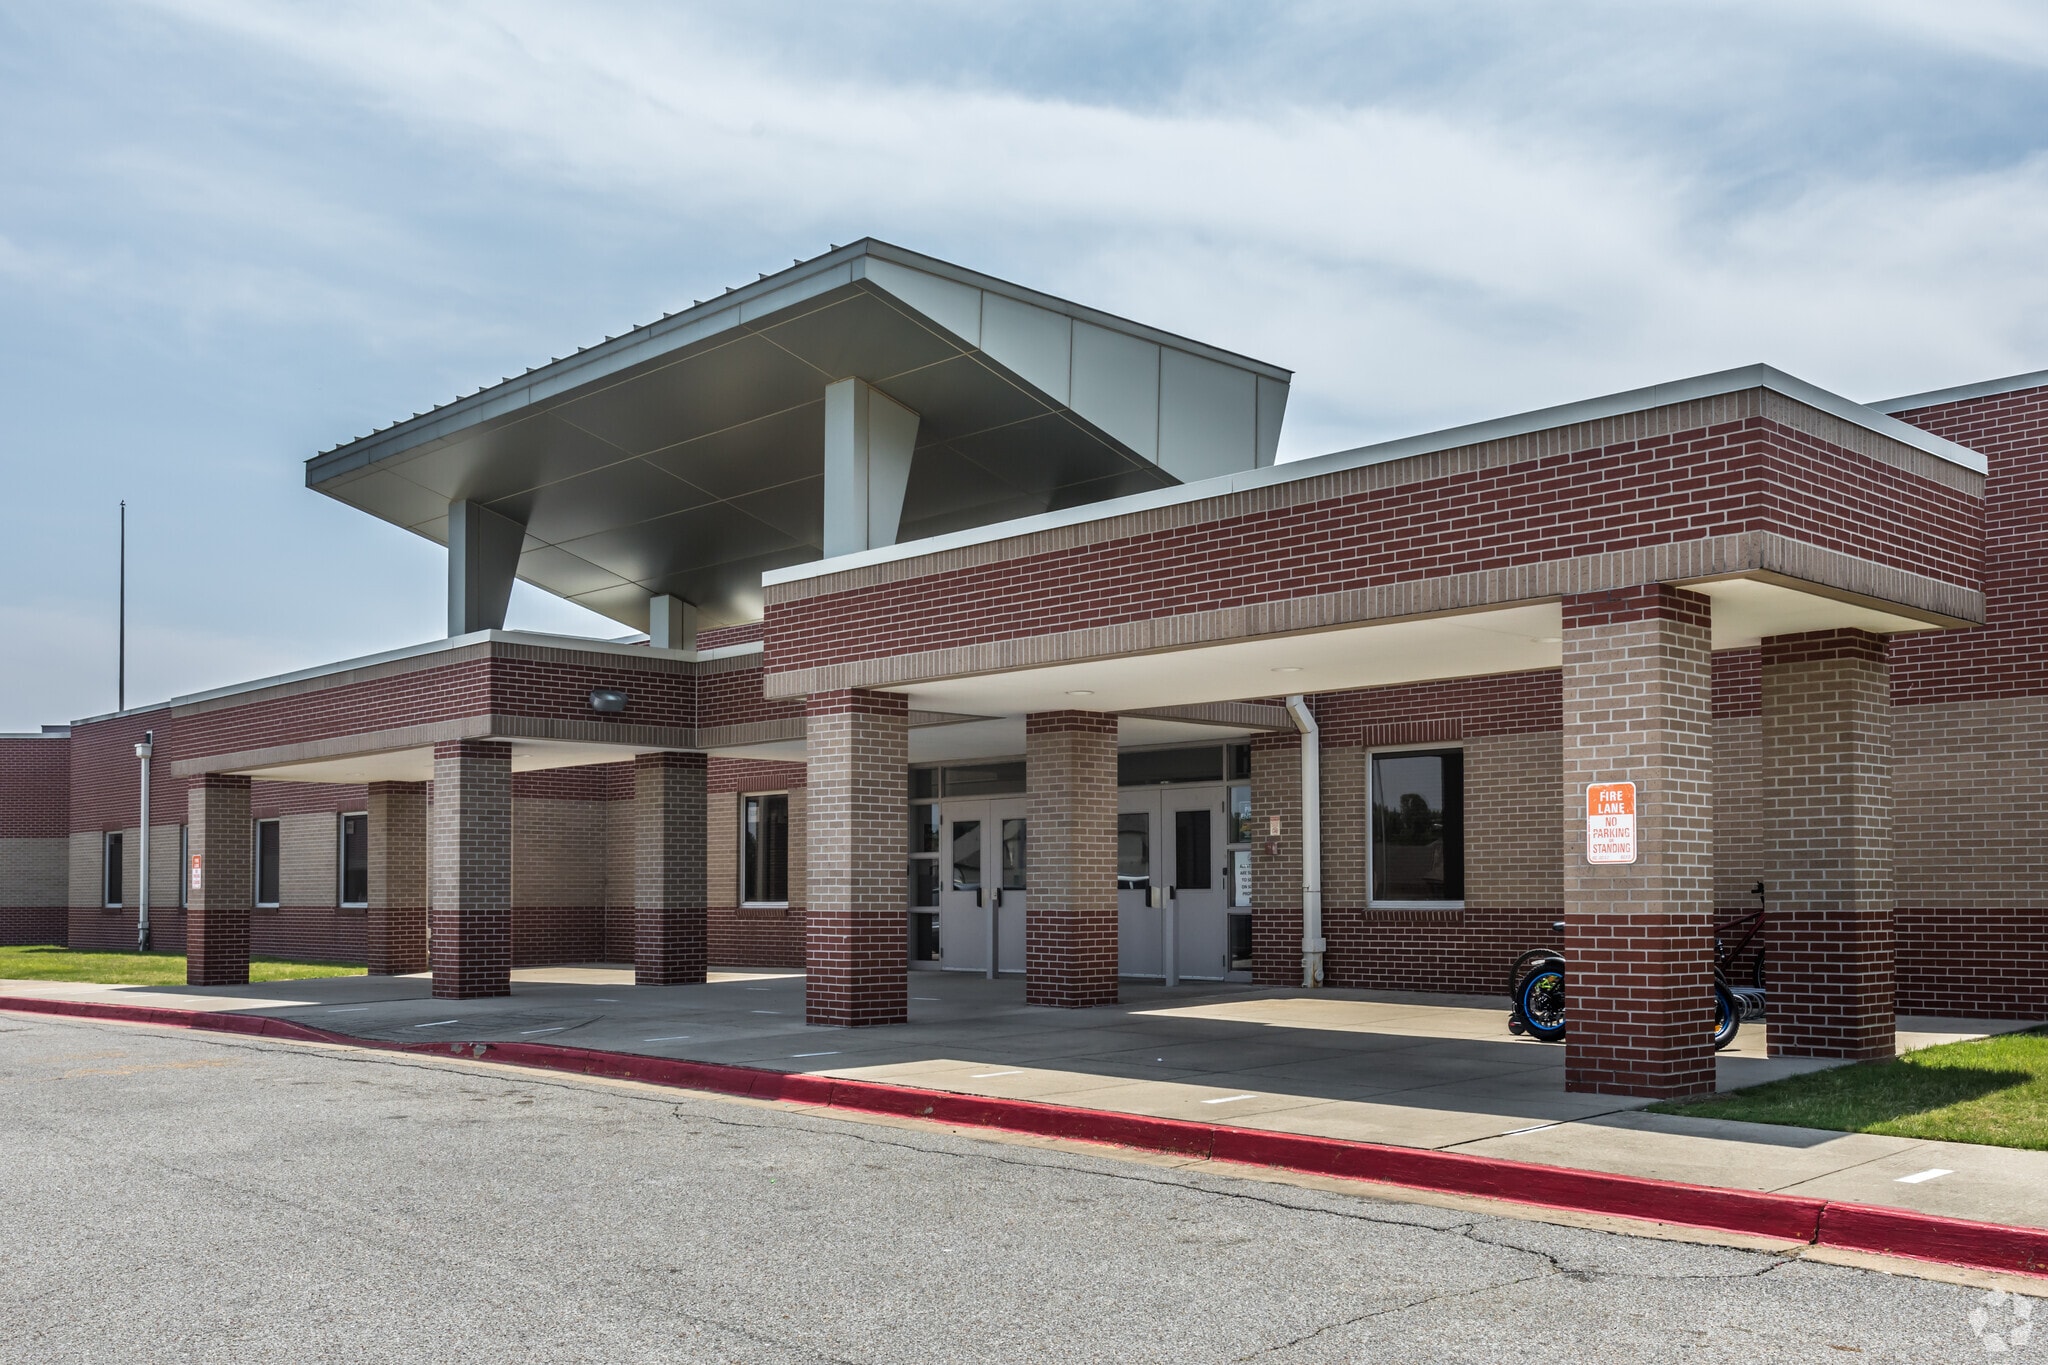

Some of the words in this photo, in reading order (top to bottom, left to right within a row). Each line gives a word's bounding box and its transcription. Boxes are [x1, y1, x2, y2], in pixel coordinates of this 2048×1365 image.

[1600, 790, 1623, 801] FIRE
[1598, 803, 1625, 814] LANE
[1605, 816, 1617, 827] NO
[1593, 828, 1630, 838] PARKING
[1593, 843, 1631, 854] STANDING
